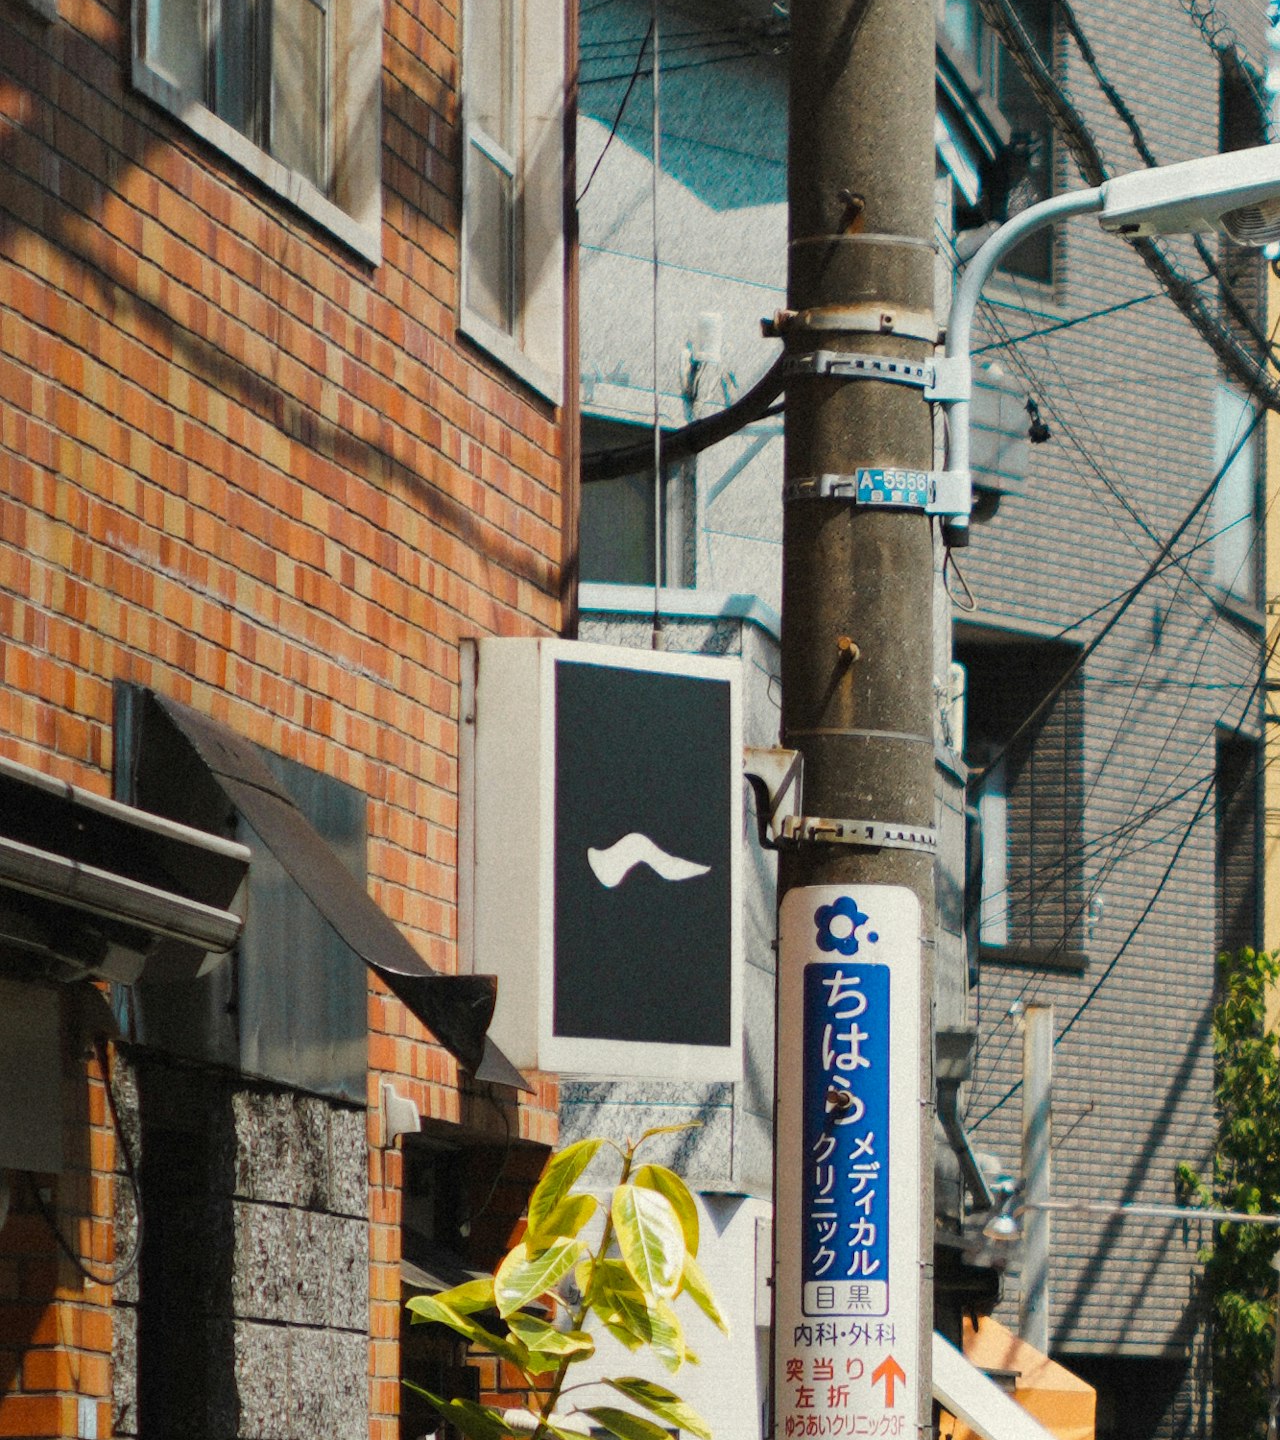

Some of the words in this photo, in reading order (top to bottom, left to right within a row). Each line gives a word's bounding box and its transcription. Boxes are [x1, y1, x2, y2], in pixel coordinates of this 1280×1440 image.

[859, 469, 927, 491] A-5556
[822, 969, 872, 1126] ちはら
[811, 1131, 837, 1277] クリニック
[846, 1131, 881, 1277] メディカル
[816, 1285, 872, 1310] 目黒
[794, 1322, 896, 1347] 内科・外科
[786, 1357, 865, 1383] 突当り
[794, 1384, 851, 1409] 左折
[785, 1414, 906, 1438] ゆうあいクリニック3F
